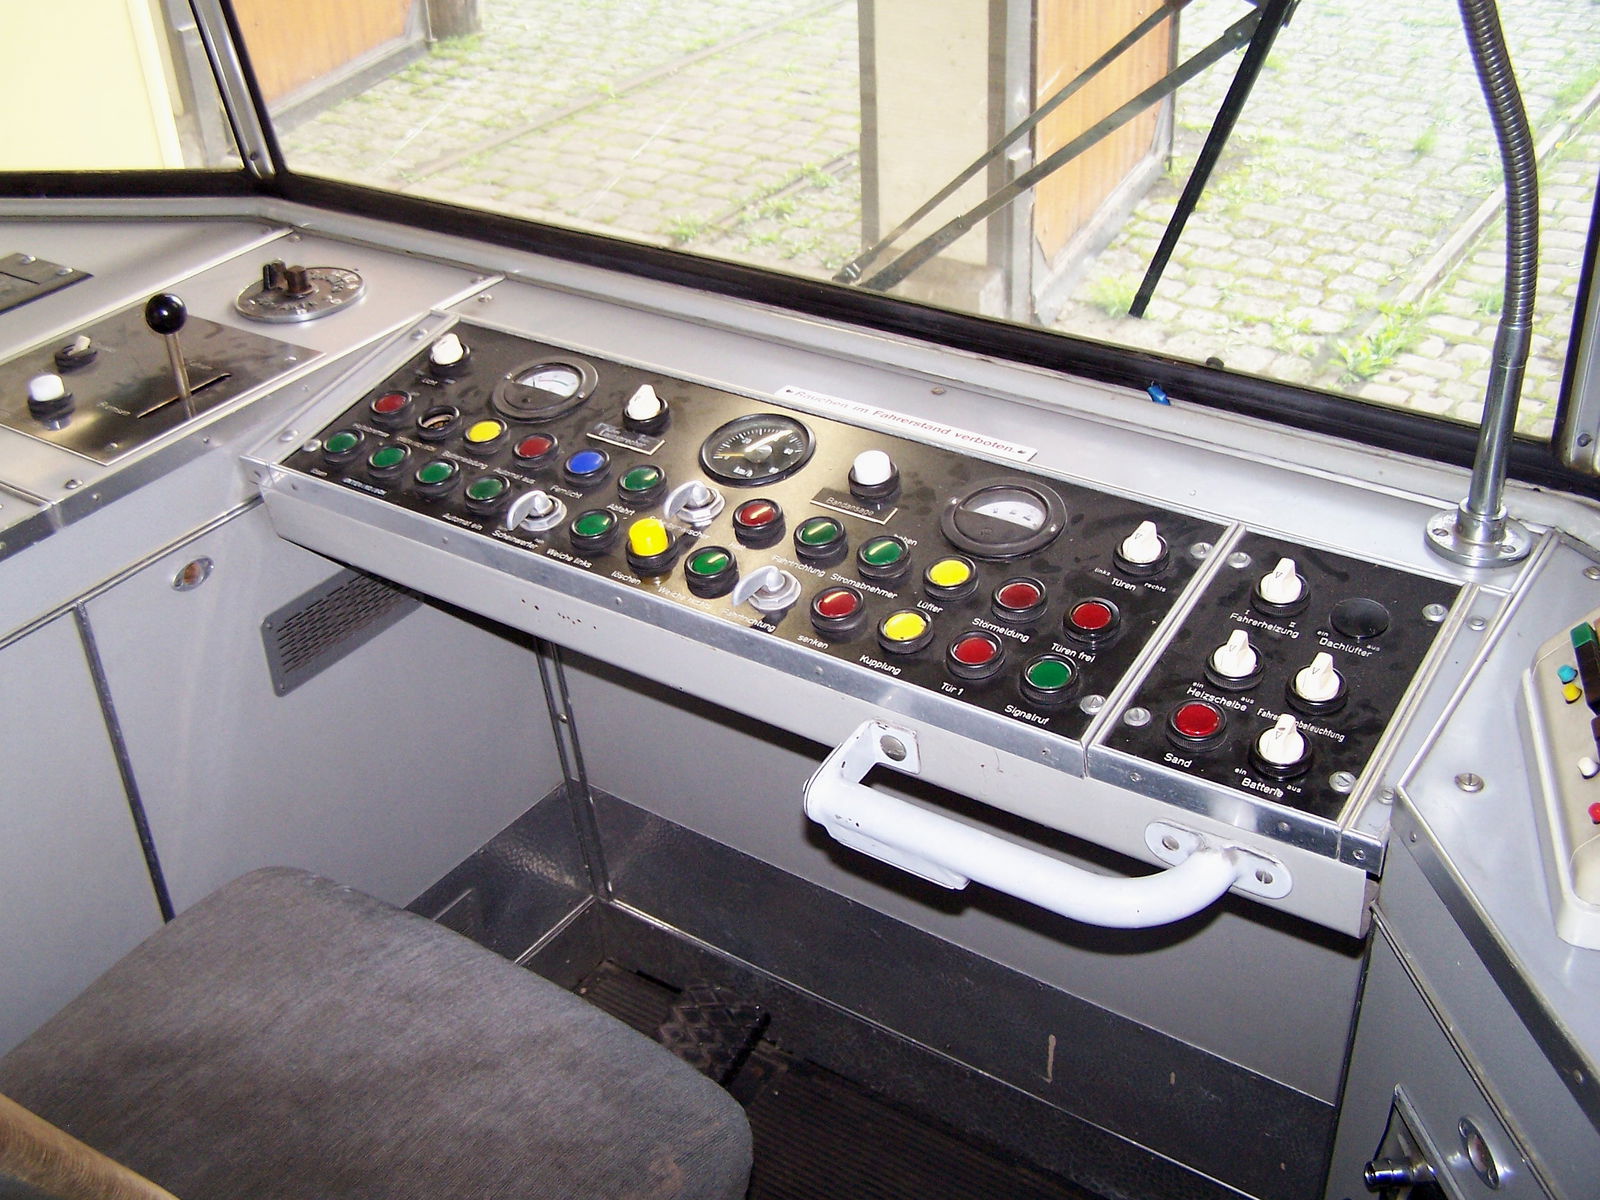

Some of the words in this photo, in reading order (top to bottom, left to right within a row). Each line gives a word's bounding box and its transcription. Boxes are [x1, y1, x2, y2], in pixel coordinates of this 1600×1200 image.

[872, 409, 952, 435] Fahrerstand
[826, 495, 876, 517] Bandansage
[611, 571, 642, 587] löschen
[830, 572, 898, 600] Stromabnehmer
[1111, 576, 1136, 592] Türen
[916, 599, 944, 615] Lüfter
[1229, 611, 1301, 639] Fahrerheizung
[796, 634, 829, 651] senken
[1051, 641, 1079, 660] Türen
[1077, 649, 1096, 664] frei
[1318, 636, 1373, 658] Dachlüfter
[858, 653, 902, 677] Kupplung
[939, 681, 959, 696] Tür
[1186, 686, 1249, 713] Heizscheibe
[1004, 704, 1051, 727] Signalruf
[1163, 751, 1193, 770] Sand
[1241, 776, 1285, 799] Batterie
